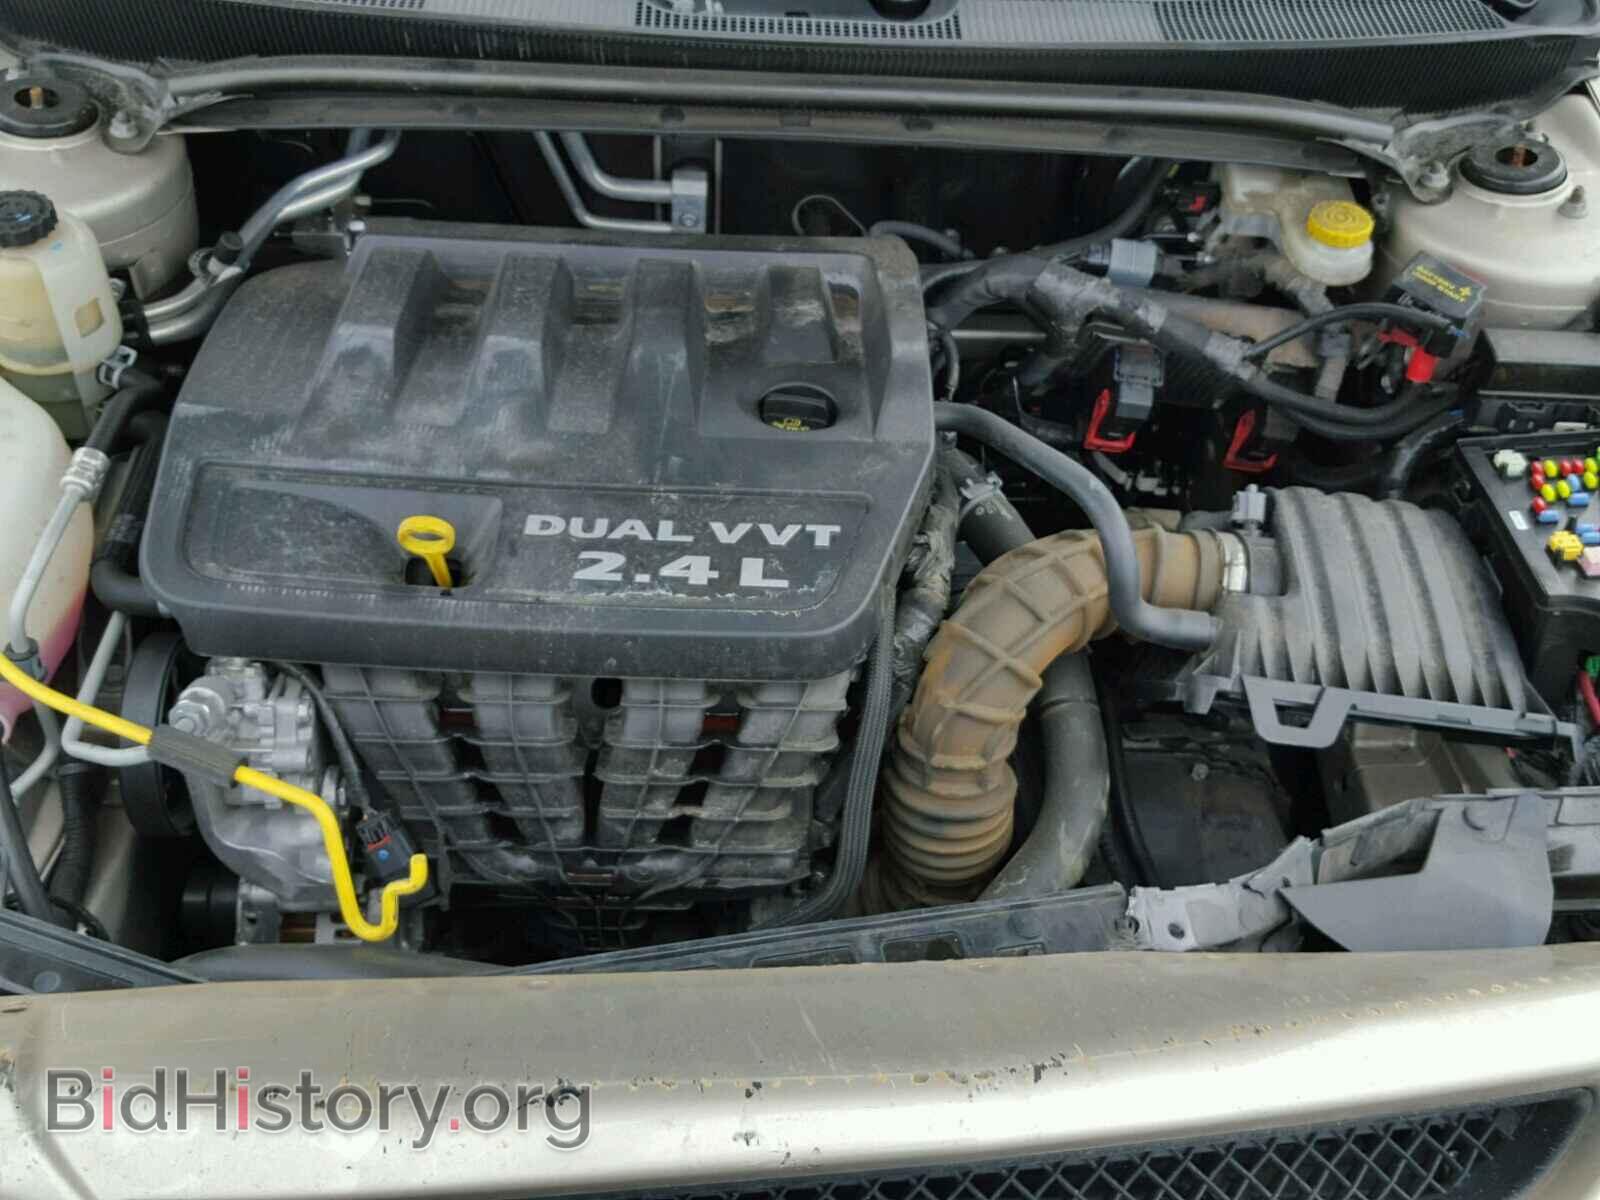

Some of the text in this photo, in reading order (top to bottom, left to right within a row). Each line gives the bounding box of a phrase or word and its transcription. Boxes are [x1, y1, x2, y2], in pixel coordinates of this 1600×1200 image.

[523, 513, 842, 547] DUAL VVT
[573, 550, 790, 588] 2.4 L
